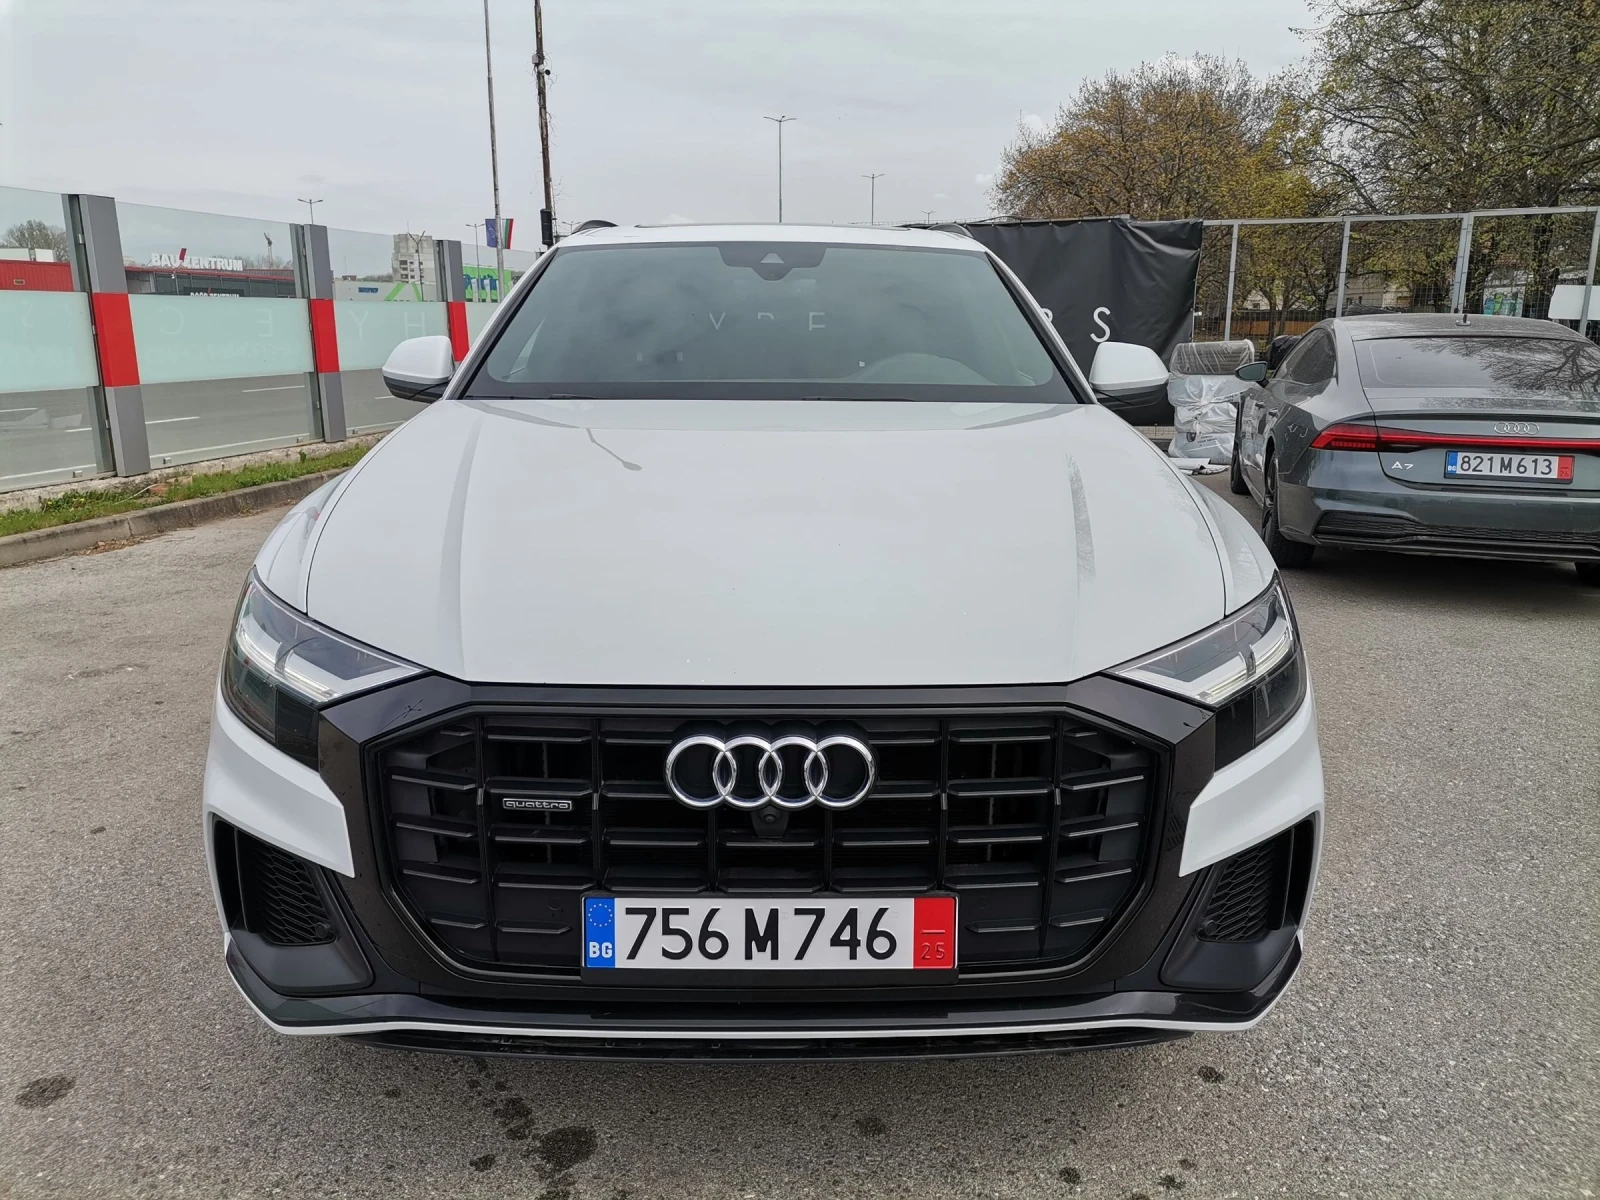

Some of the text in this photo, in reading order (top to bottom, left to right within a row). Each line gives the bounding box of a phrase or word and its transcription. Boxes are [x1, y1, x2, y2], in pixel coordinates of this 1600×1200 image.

[1391, 461, 1414, 470] A7
[505, 801, 569, 809] quattro
[588, 941, 613, 958] BG
[920, 942, 946, 960] 25
